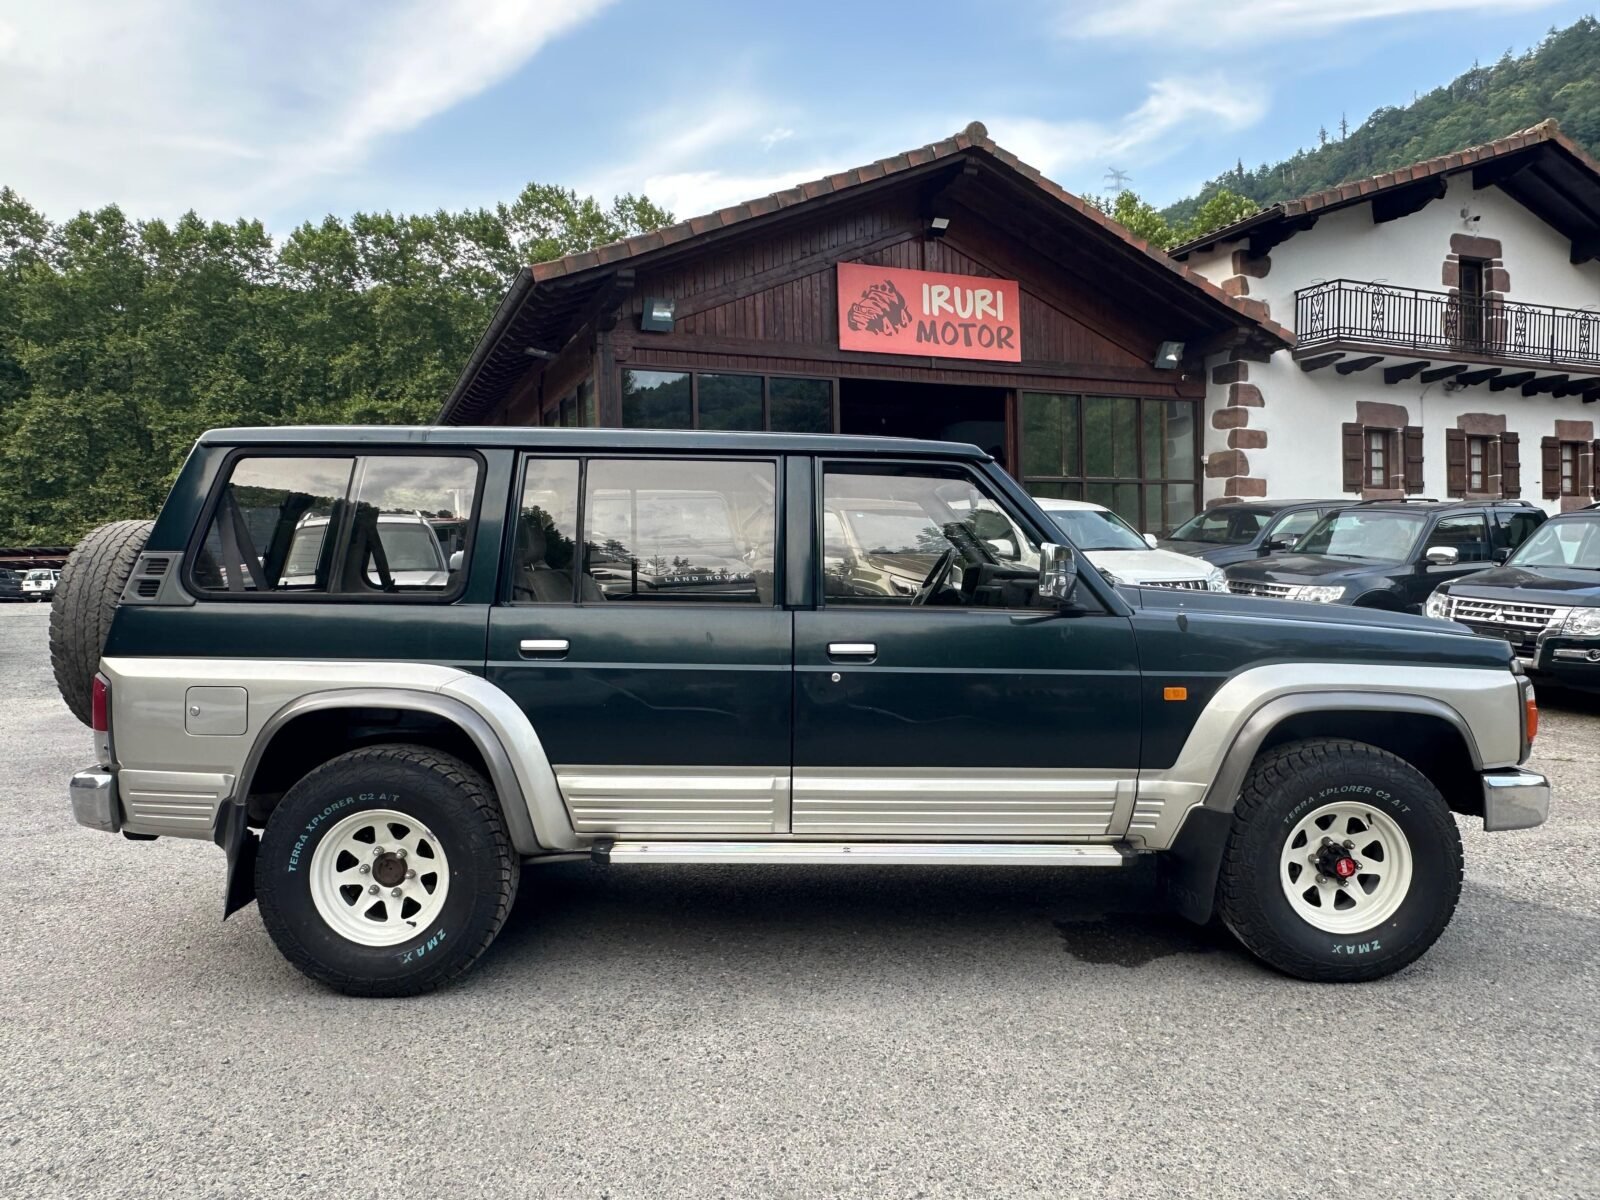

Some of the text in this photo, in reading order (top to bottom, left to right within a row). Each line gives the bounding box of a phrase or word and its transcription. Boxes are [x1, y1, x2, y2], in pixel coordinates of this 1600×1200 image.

[922, 283, 1004, 321] IRURI
[916, 319, 1014, 349] MOTOR
[1283, 785, 1411, 824] TERRA XPLORER C2 A/T
[288, 793, 400, 873] TERRA XPLORER C2 A/T
[402, 928, 447, 964] ZMAX
[1331, 940, 1381, 955] ZMAX
